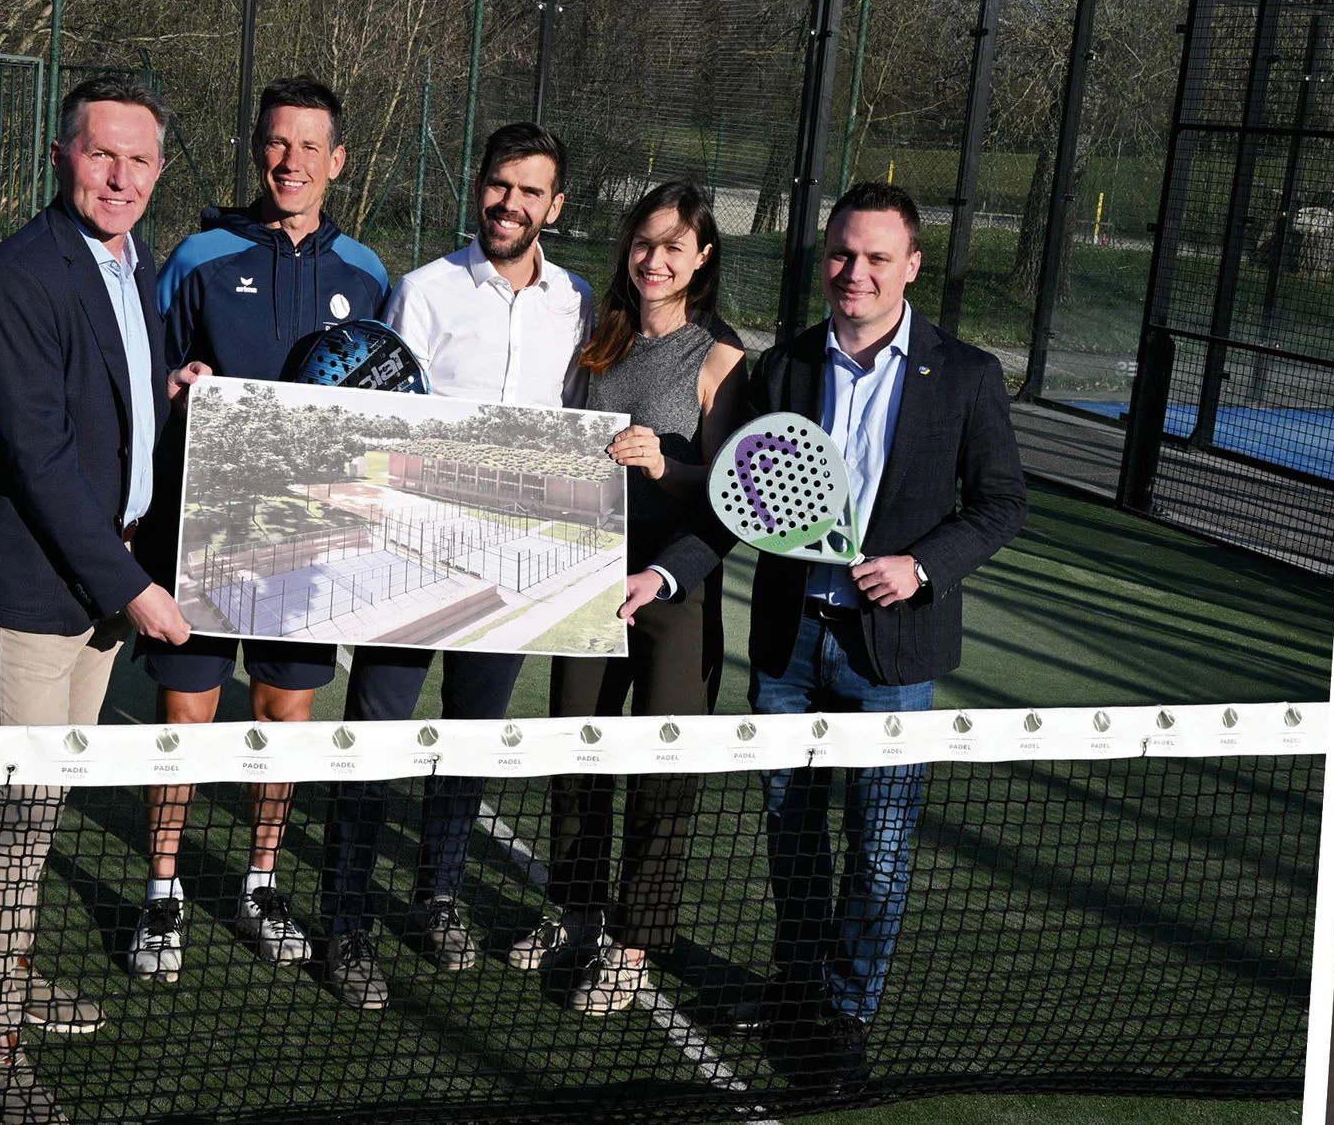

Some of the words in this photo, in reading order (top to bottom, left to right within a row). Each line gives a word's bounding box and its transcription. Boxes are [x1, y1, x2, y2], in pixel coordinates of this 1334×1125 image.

[948, 743, 972, 751] PADEL
[655, 753, 680, 761] PADEL
[153, 764, 180, 772] PADEL
[241, 762, 269, 770] PADEL
[329, 761, 356, 769] PADEL
[60, 766, 89, 774] PADEL
